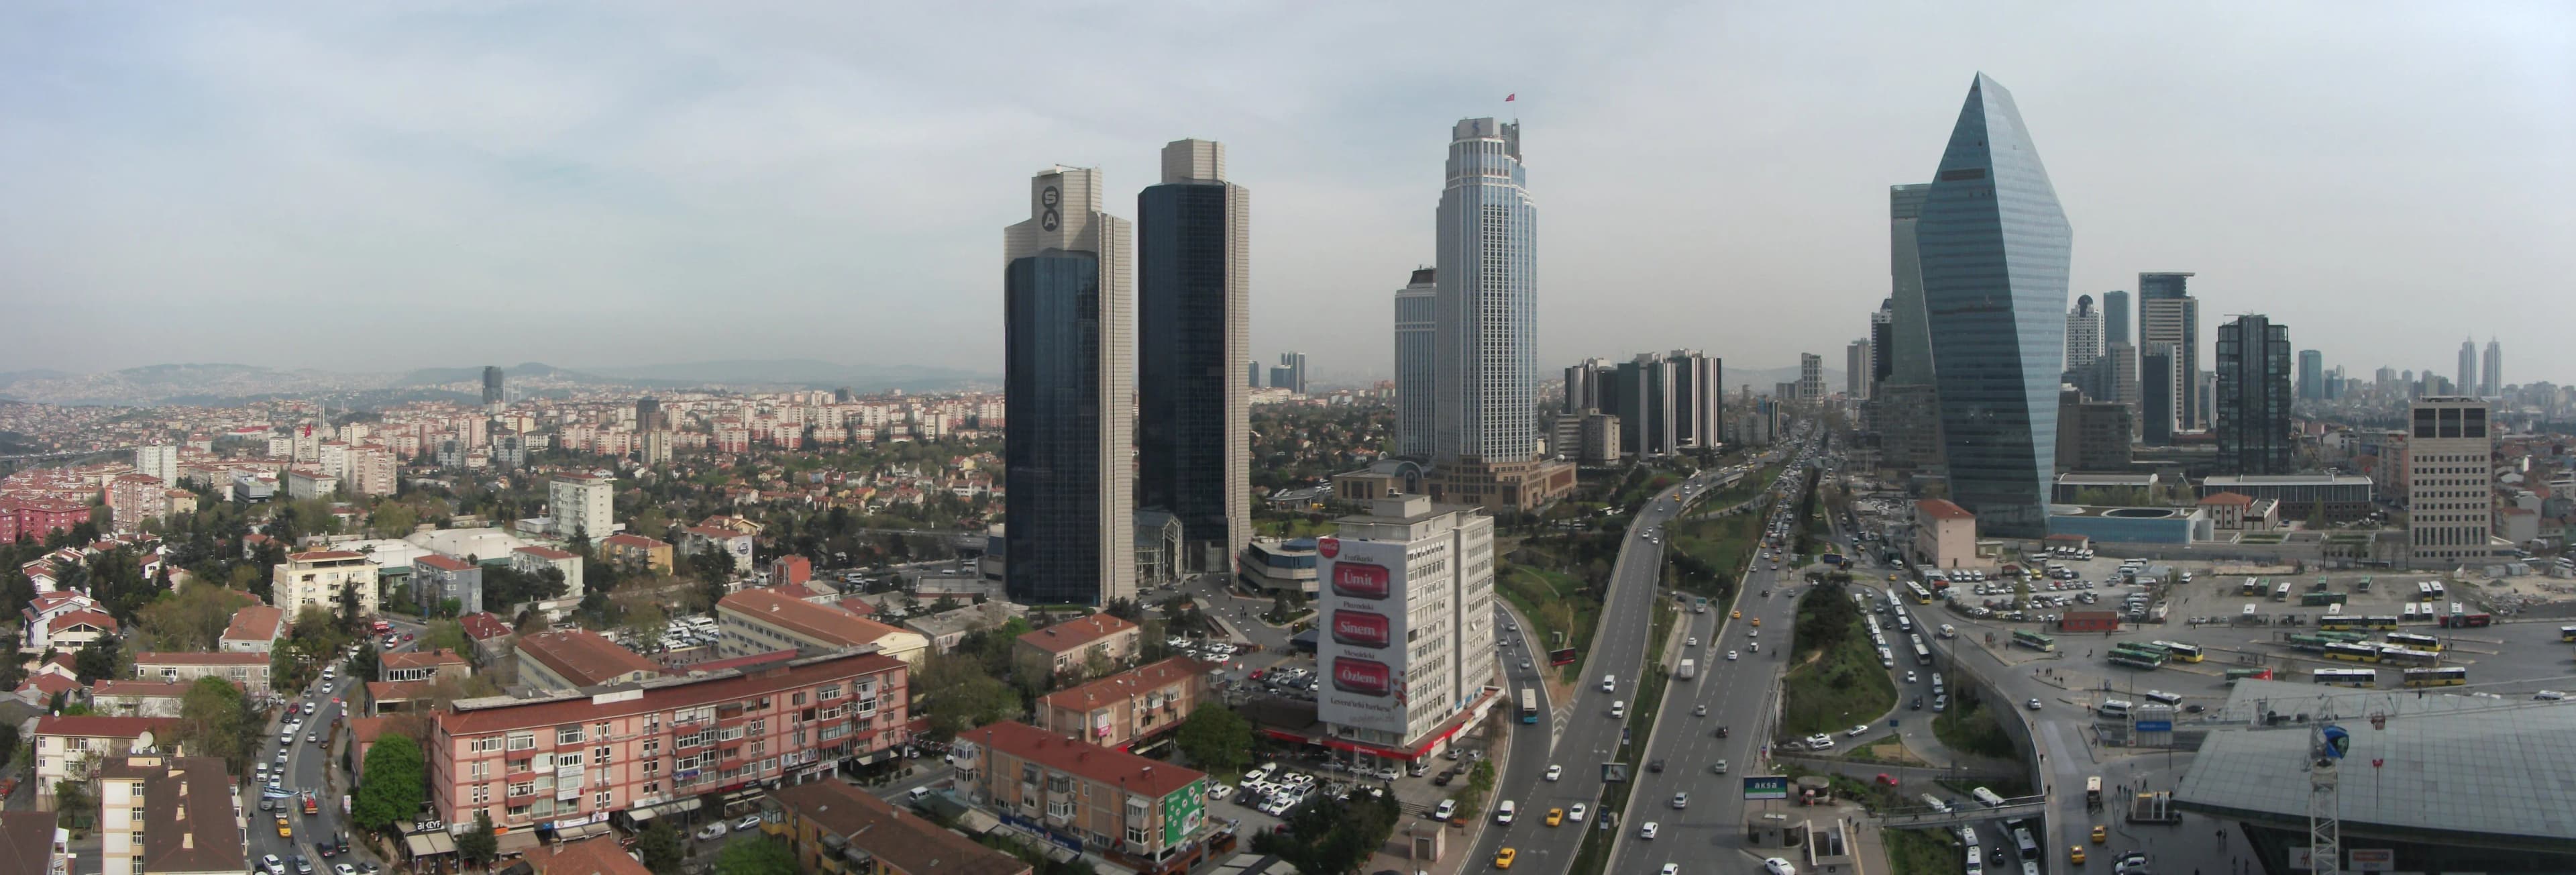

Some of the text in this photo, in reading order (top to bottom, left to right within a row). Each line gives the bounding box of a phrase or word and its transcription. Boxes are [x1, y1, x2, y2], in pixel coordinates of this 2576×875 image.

[1344, 569, 1373, 586] Ümit
[1340, 621, 1377, 636] Sinem
[1342, 666, 1377, 684] Özlem
